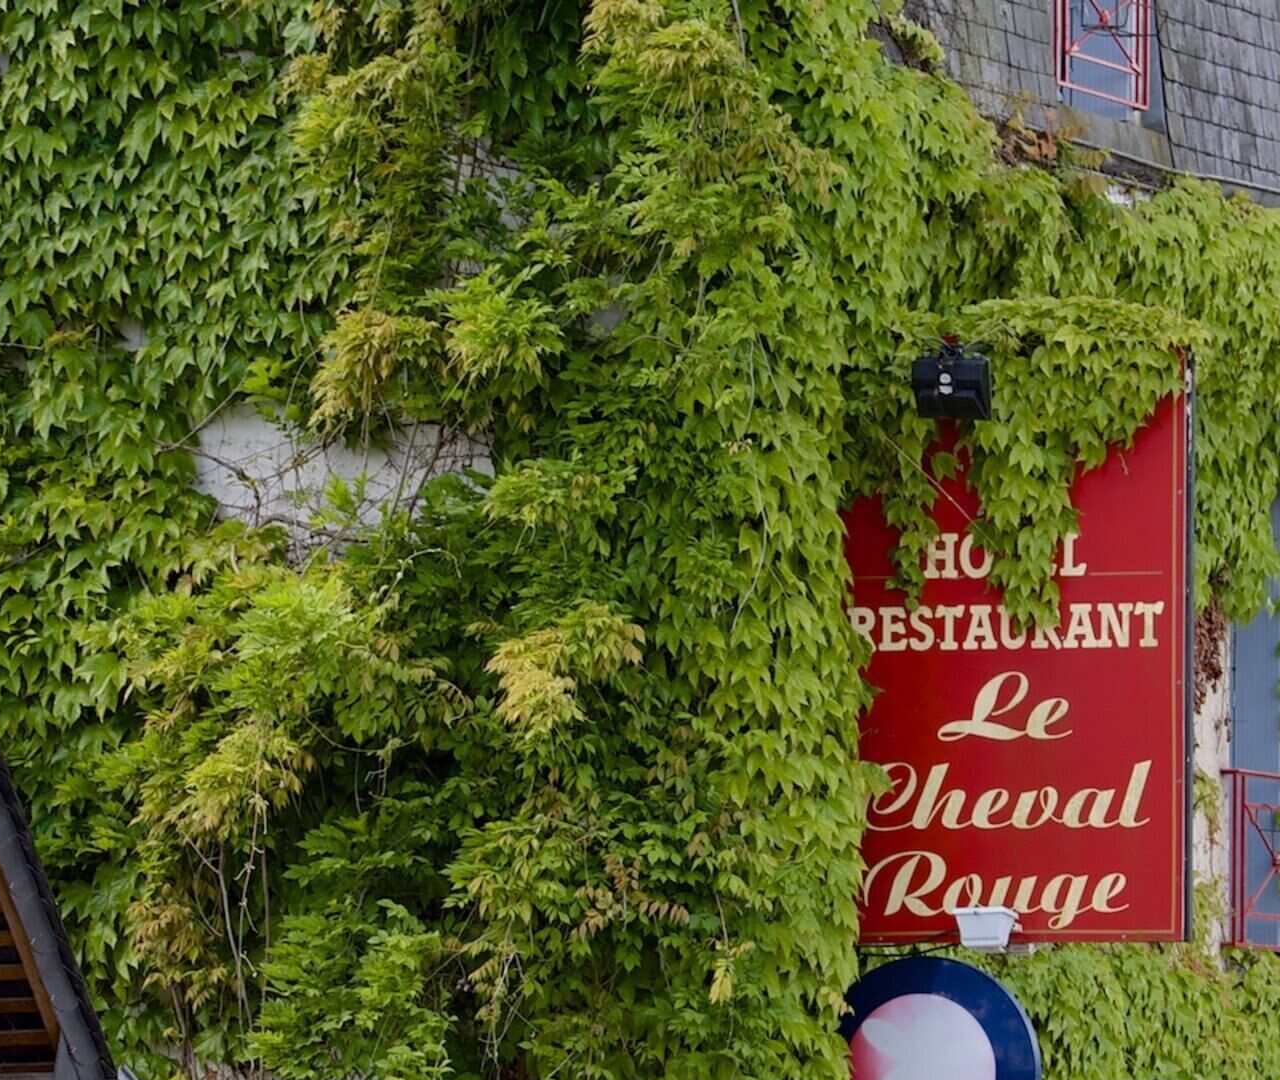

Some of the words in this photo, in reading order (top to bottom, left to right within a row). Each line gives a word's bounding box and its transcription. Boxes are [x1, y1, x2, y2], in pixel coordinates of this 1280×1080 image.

[923, 532, 1087, 580] HOL
[846, 601, 1165, 652] RESTAURANT
[936, 670, 1073, 742] Le
[866, 759, 1153, 832] Cheval
[864, 850, 1130, 931] Rouge
